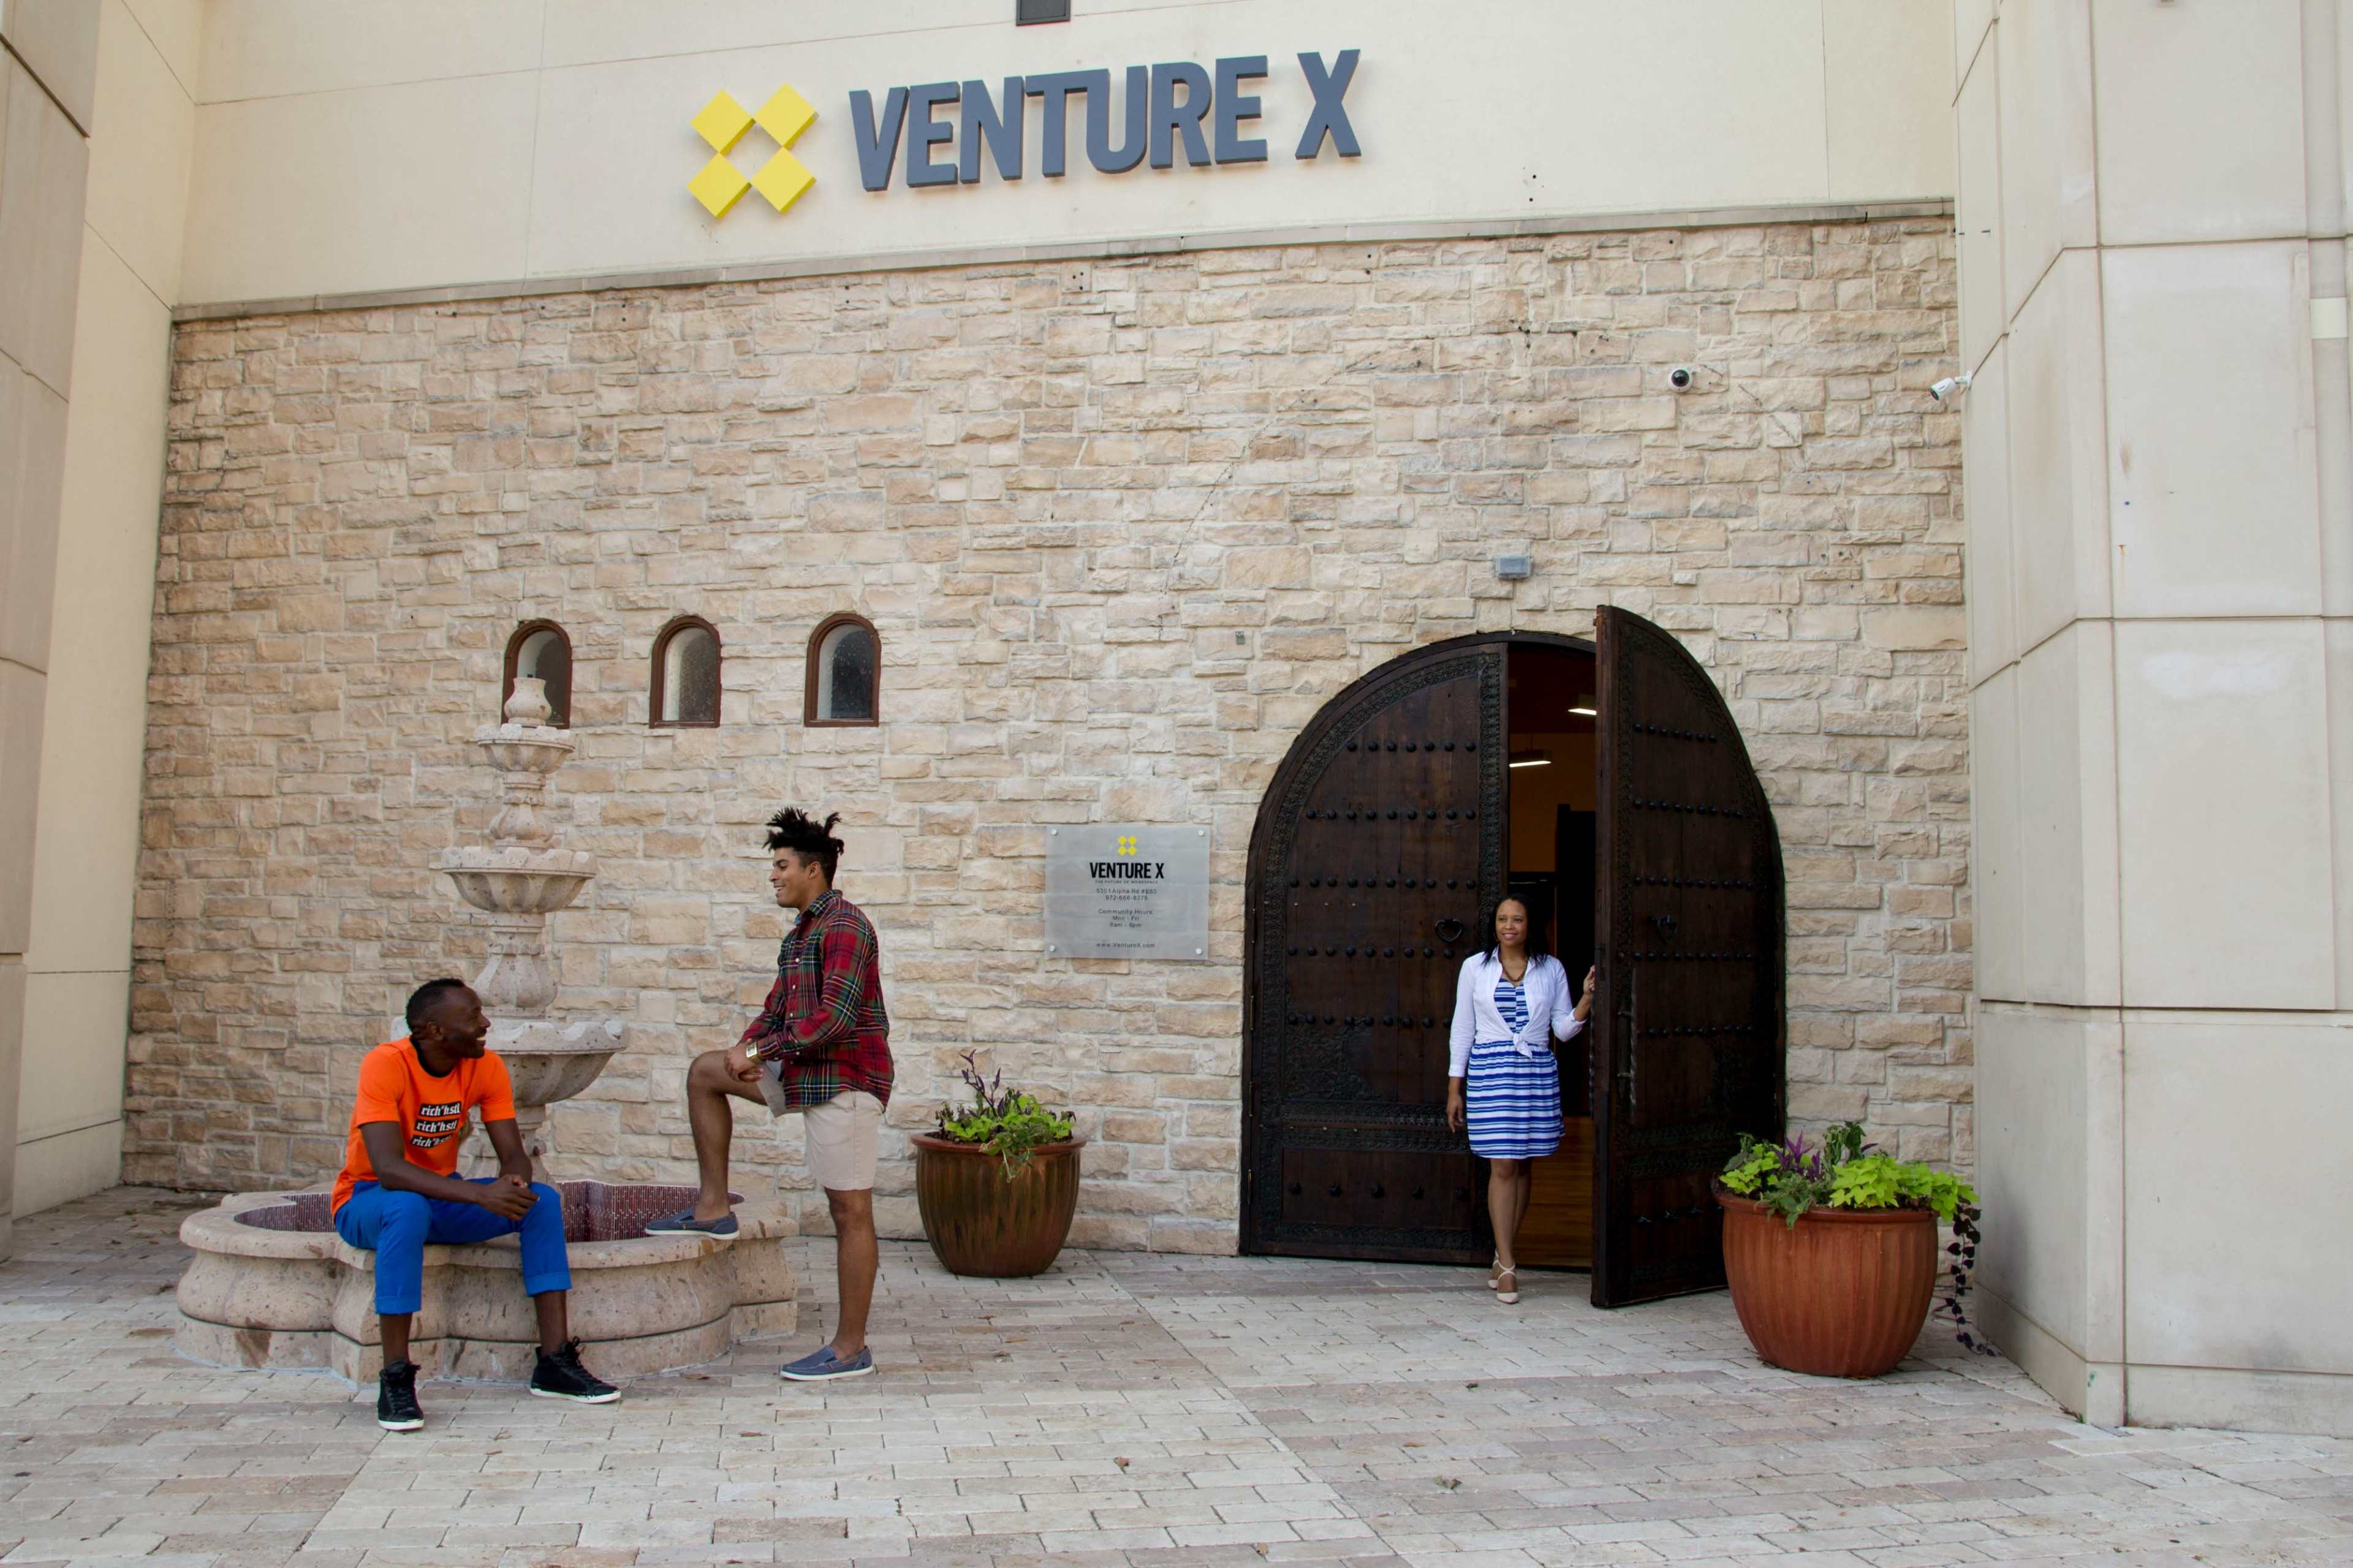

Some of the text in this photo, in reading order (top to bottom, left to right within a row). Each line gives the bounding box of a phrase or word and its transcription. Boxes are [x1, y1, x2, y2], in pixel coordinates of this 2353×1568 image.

[849, 49, 1362, 192] VENTURE X
[1089, 862, 1164, 879] VENTURE X
